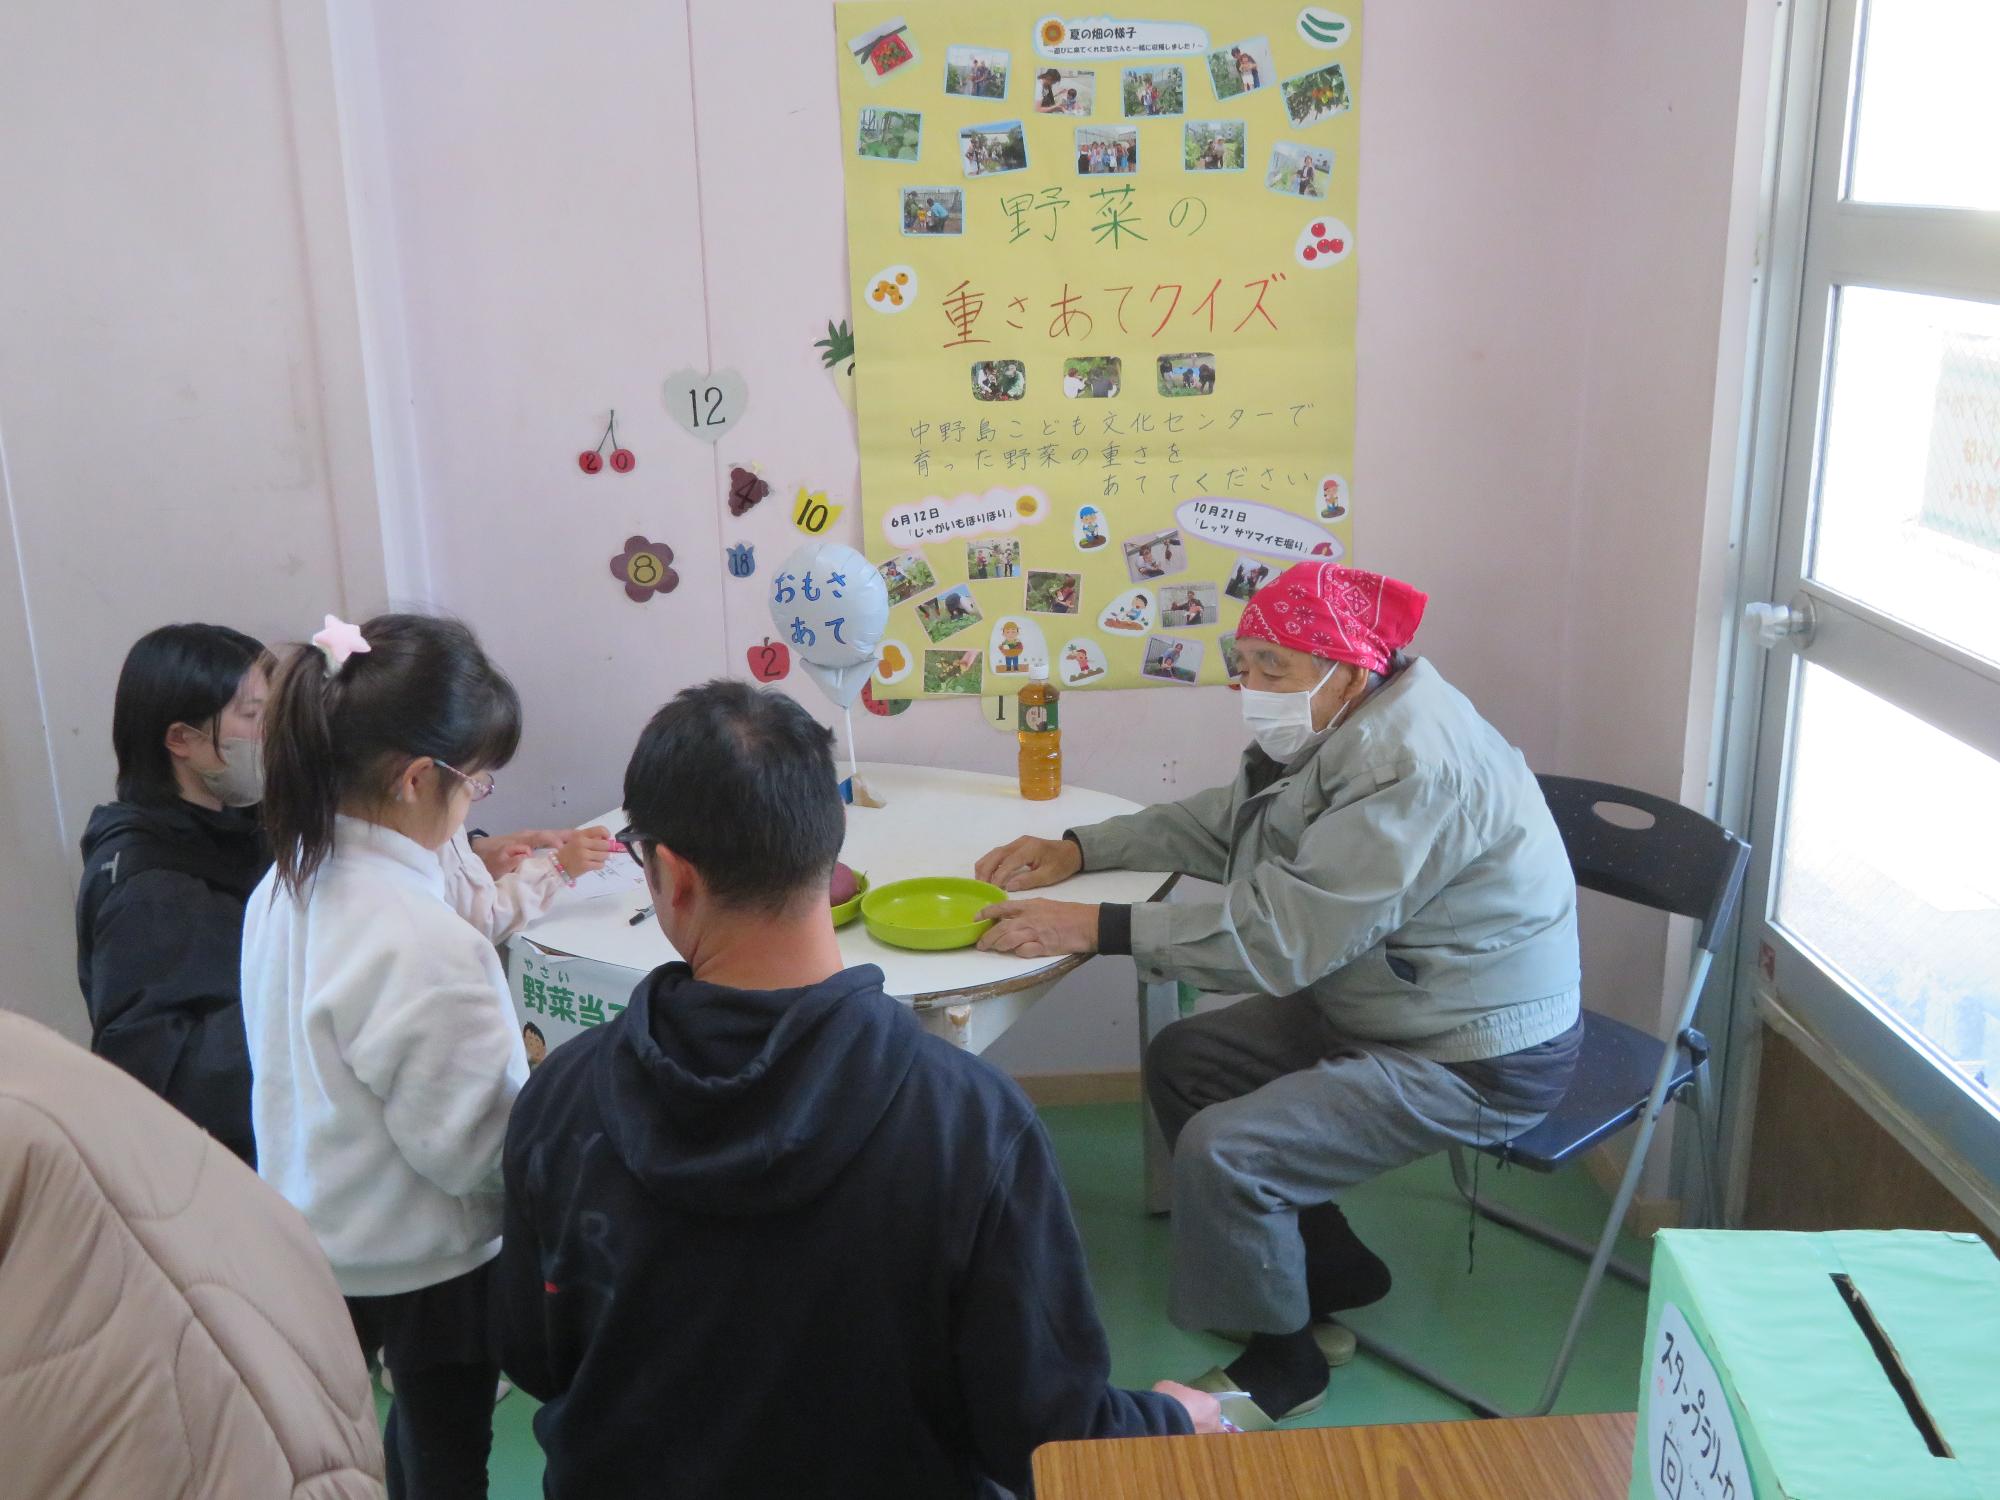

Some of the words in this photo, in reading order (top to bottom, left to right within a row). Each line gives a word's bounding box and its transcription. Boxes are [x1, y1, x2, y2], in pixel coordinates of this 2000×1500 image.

[1069, 26, 1137, 41] 夏の畑の様子
[1000, 183, 1208, 250] 野菜の
[942, 273, 1287, 349] 重さあてクイズ
[688, 386, 726, 428] 12
[910, 402, 1314, 444] 中野島こども文化センターで
[913, 440, 1184, 478] 育った野菜の重さを
[734, 476, 759, 509] 4
[1103, 466, 1309, 496] あててください
[796, 498, 829, 533] 10
[891, 507, 940, 528] 6月12日
[908, 509, 1012, 538] 「じゃがいもほりほり」
[1194, 502, 1247, 522] 10月21日
[633, 554, 657, 584] 8
[730, 553, 750, 577] 18
[774, 571, 847, 604] おもさ
[790, 616, 847, 647] あて
[760, 647, 782, 677] 2
[524, 958, 570, 983] やさい
